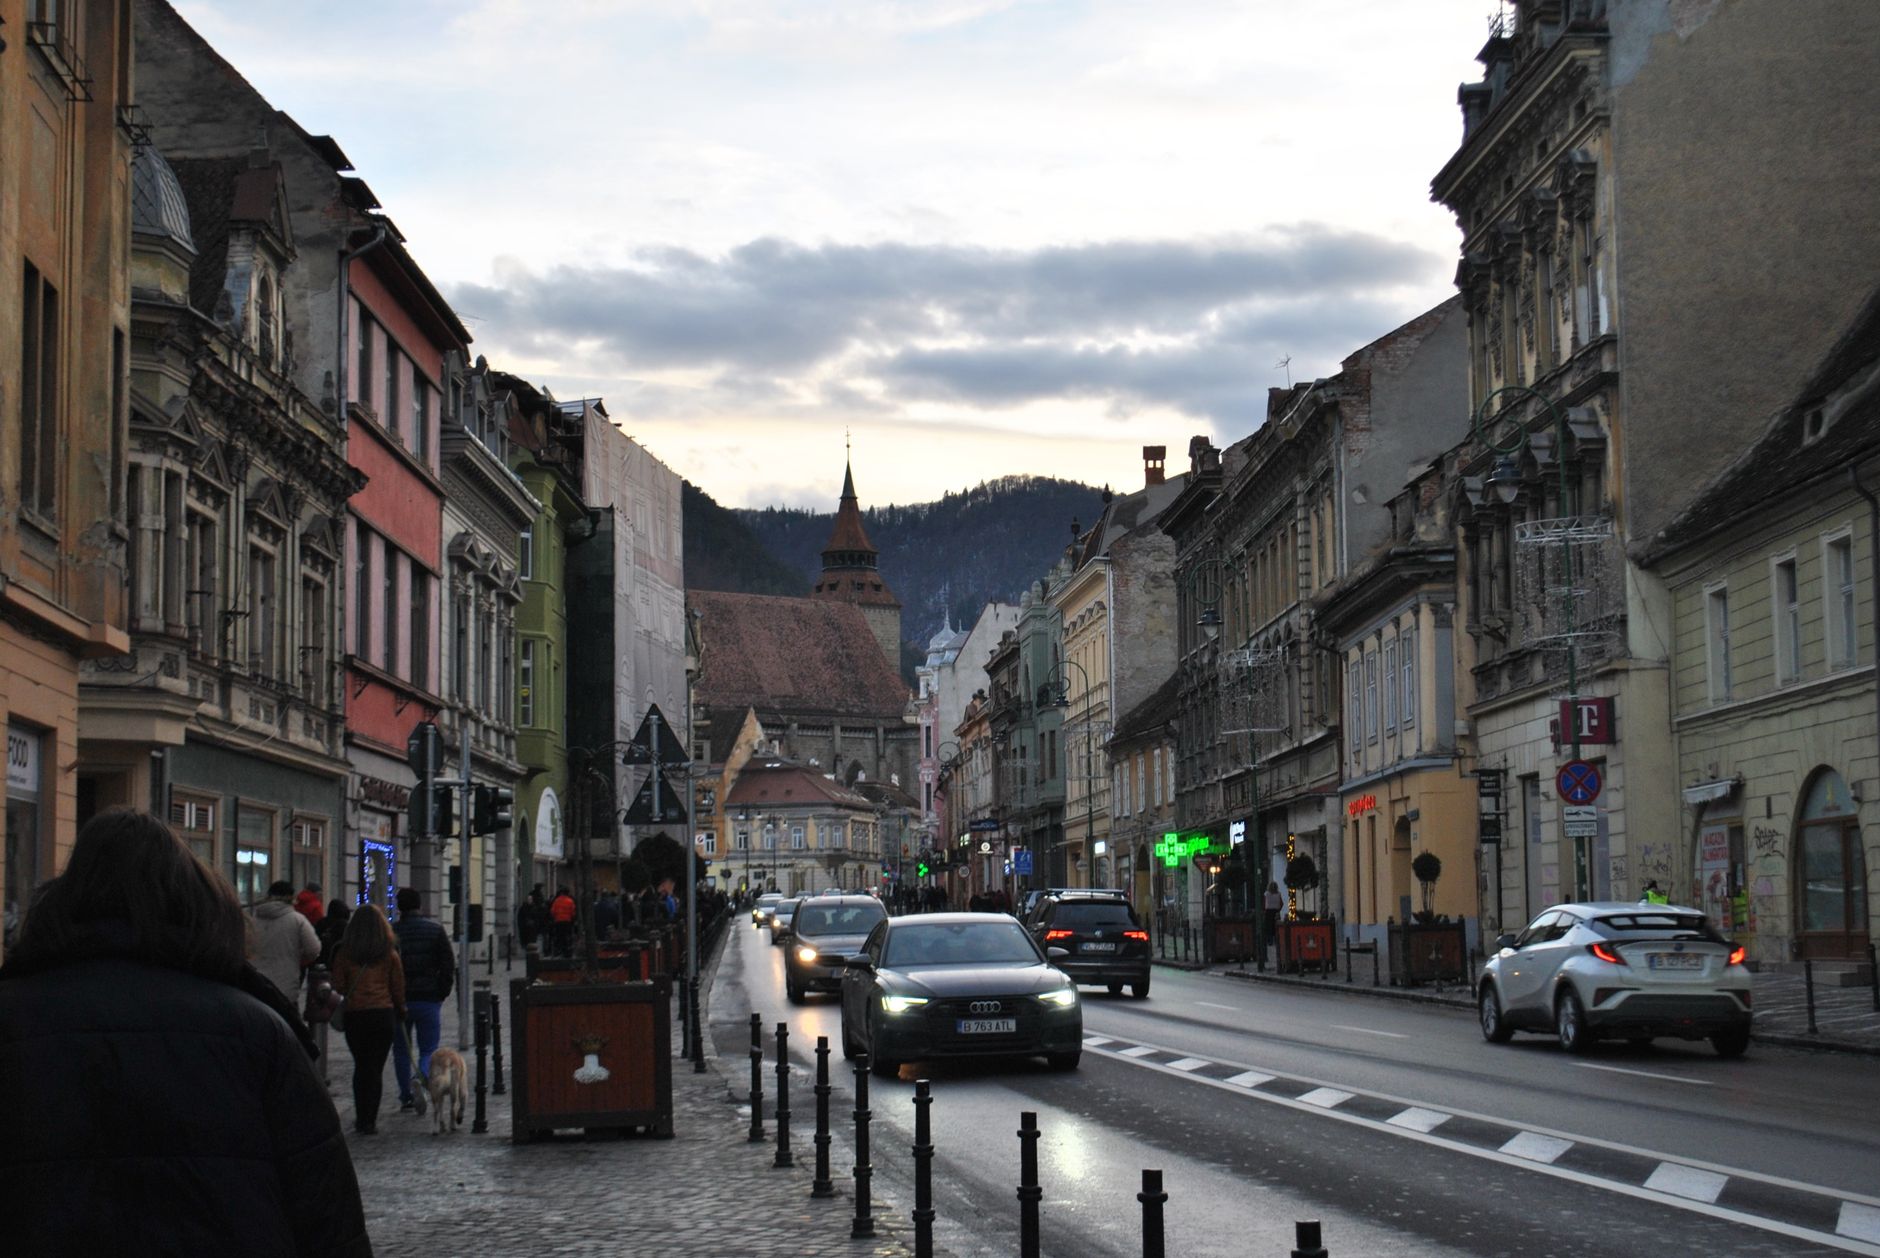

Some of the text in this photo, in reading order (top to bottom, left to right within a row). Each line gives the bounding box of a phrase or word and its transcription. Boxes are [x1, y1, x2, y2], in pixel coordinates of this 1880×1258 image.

[964, 1020, 1013, 1032] B 763 ATL
